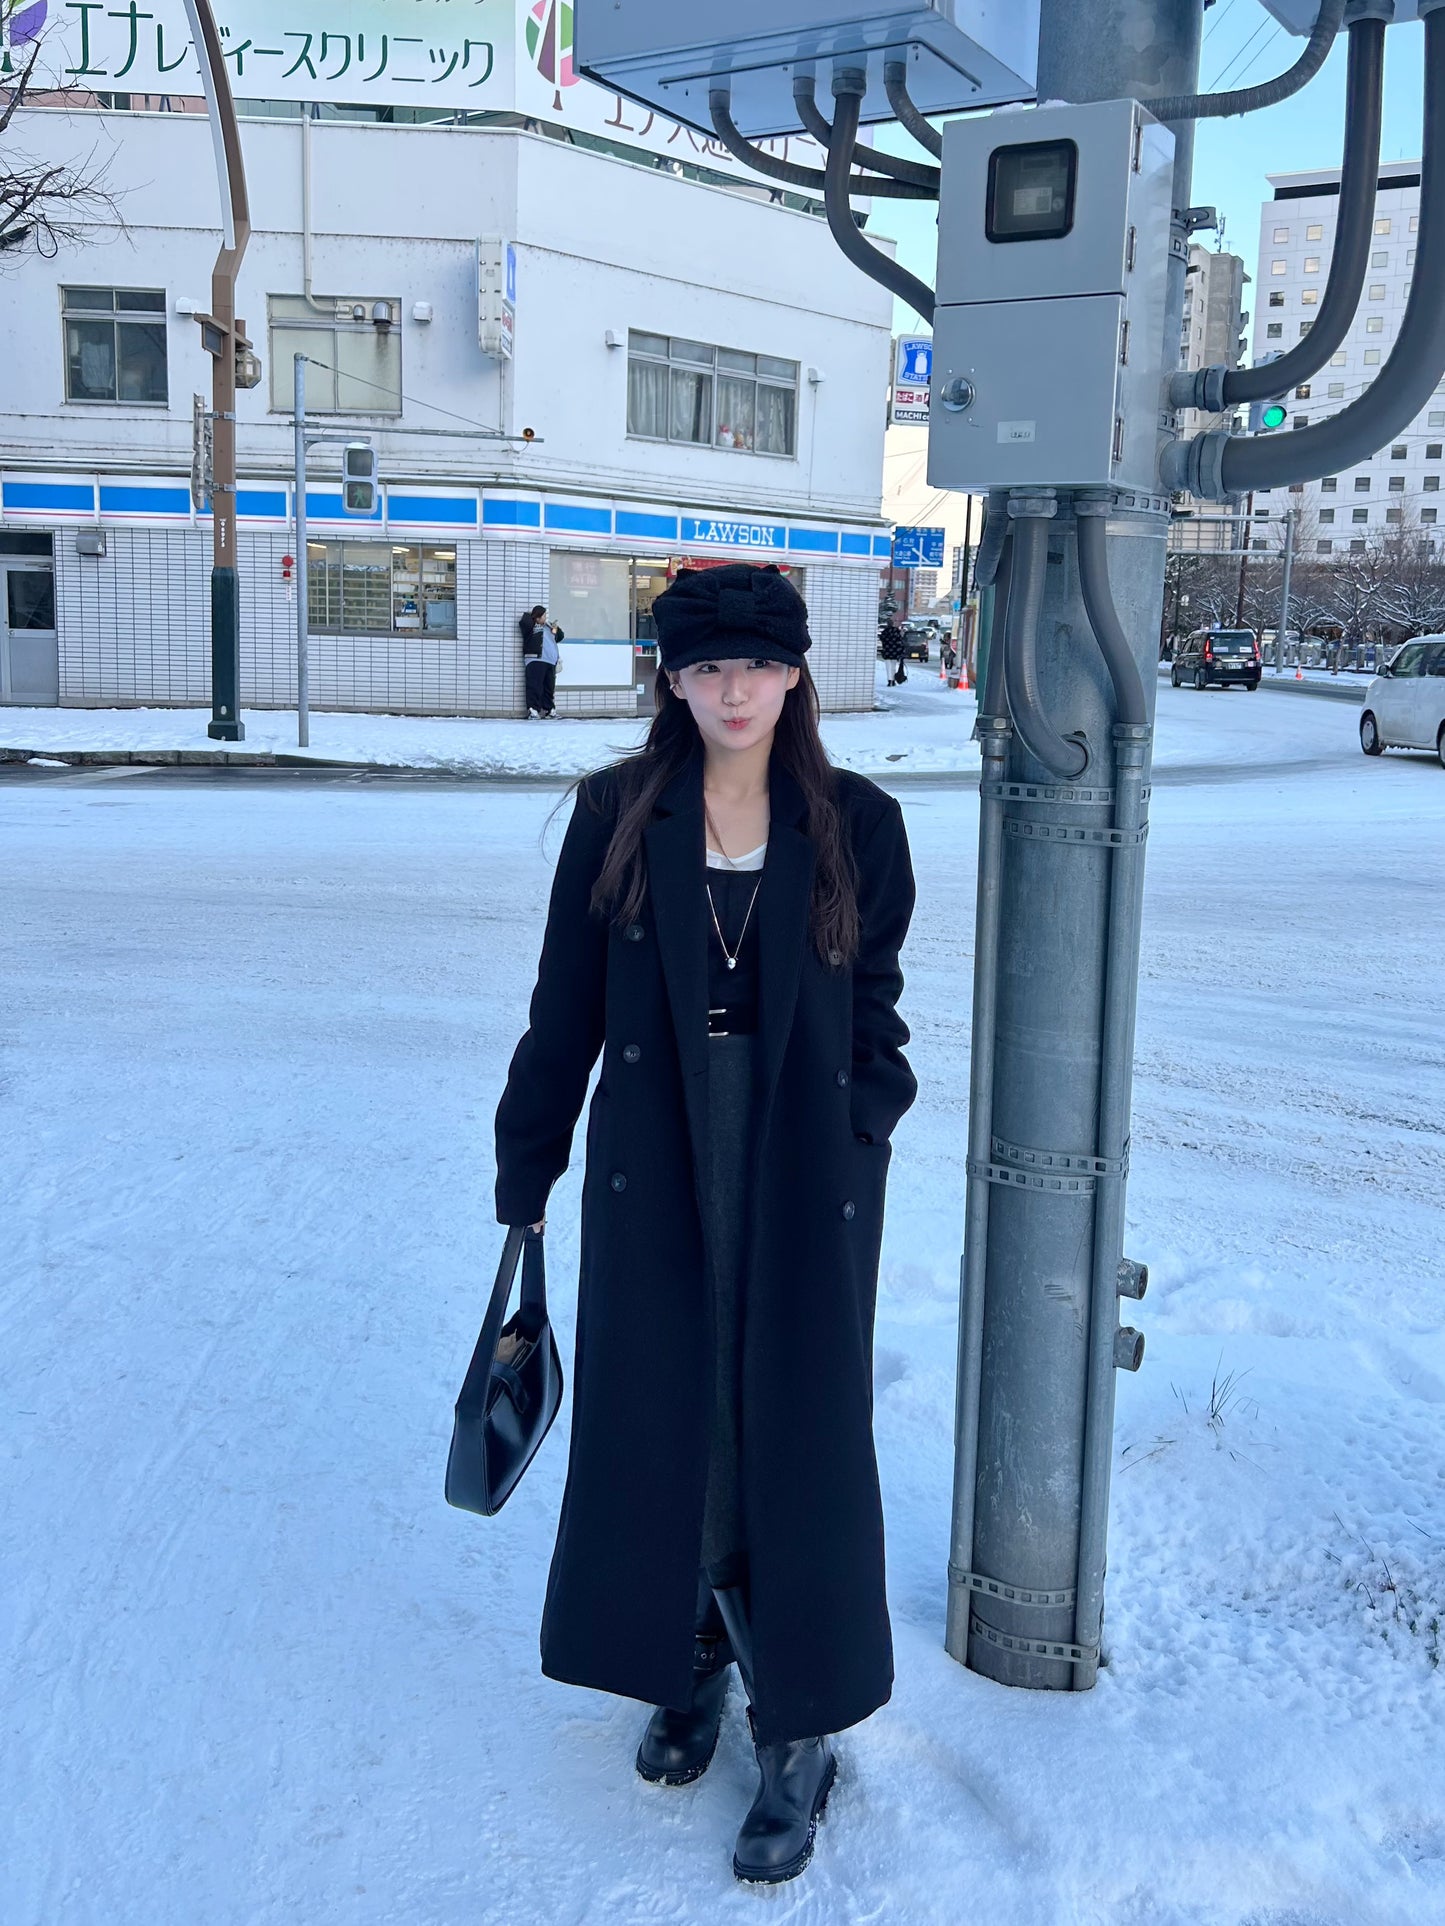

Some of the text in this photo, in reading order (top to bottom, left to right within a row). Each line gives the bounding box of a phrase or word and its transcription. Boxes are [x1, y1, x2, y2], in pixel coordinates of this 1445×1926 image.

[65, 0, 494, 88] エナレィースクリニック
[905, 343, 933, 352] LAWSO
[896, 411, 922, 420] MACHI
[693, 520, 775, 546] LAWSON
